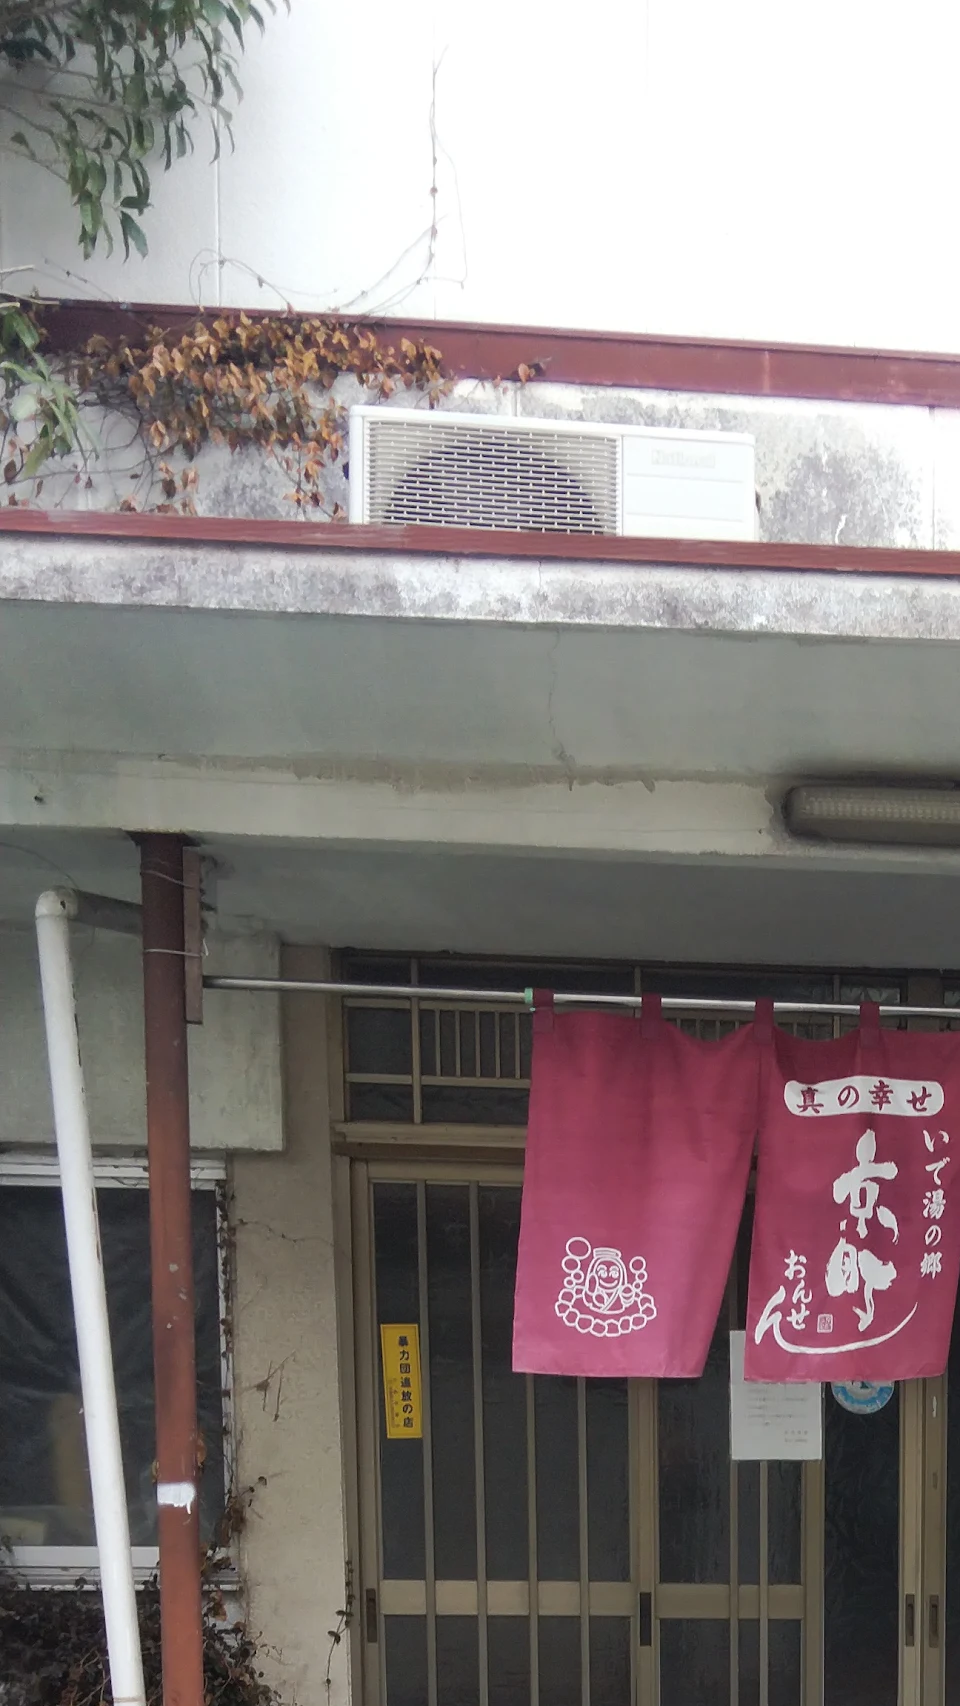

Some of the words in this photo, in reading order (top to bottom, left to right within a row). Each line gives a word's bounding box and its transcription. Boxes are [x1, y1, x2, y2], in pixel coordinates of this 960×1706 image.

[796, 1080, 932, 1114] 真の幸せ
[920, 1129, 950, 1279] いで湯の郷
[398, 1335, 414, 1428] 暴力団追放の店
